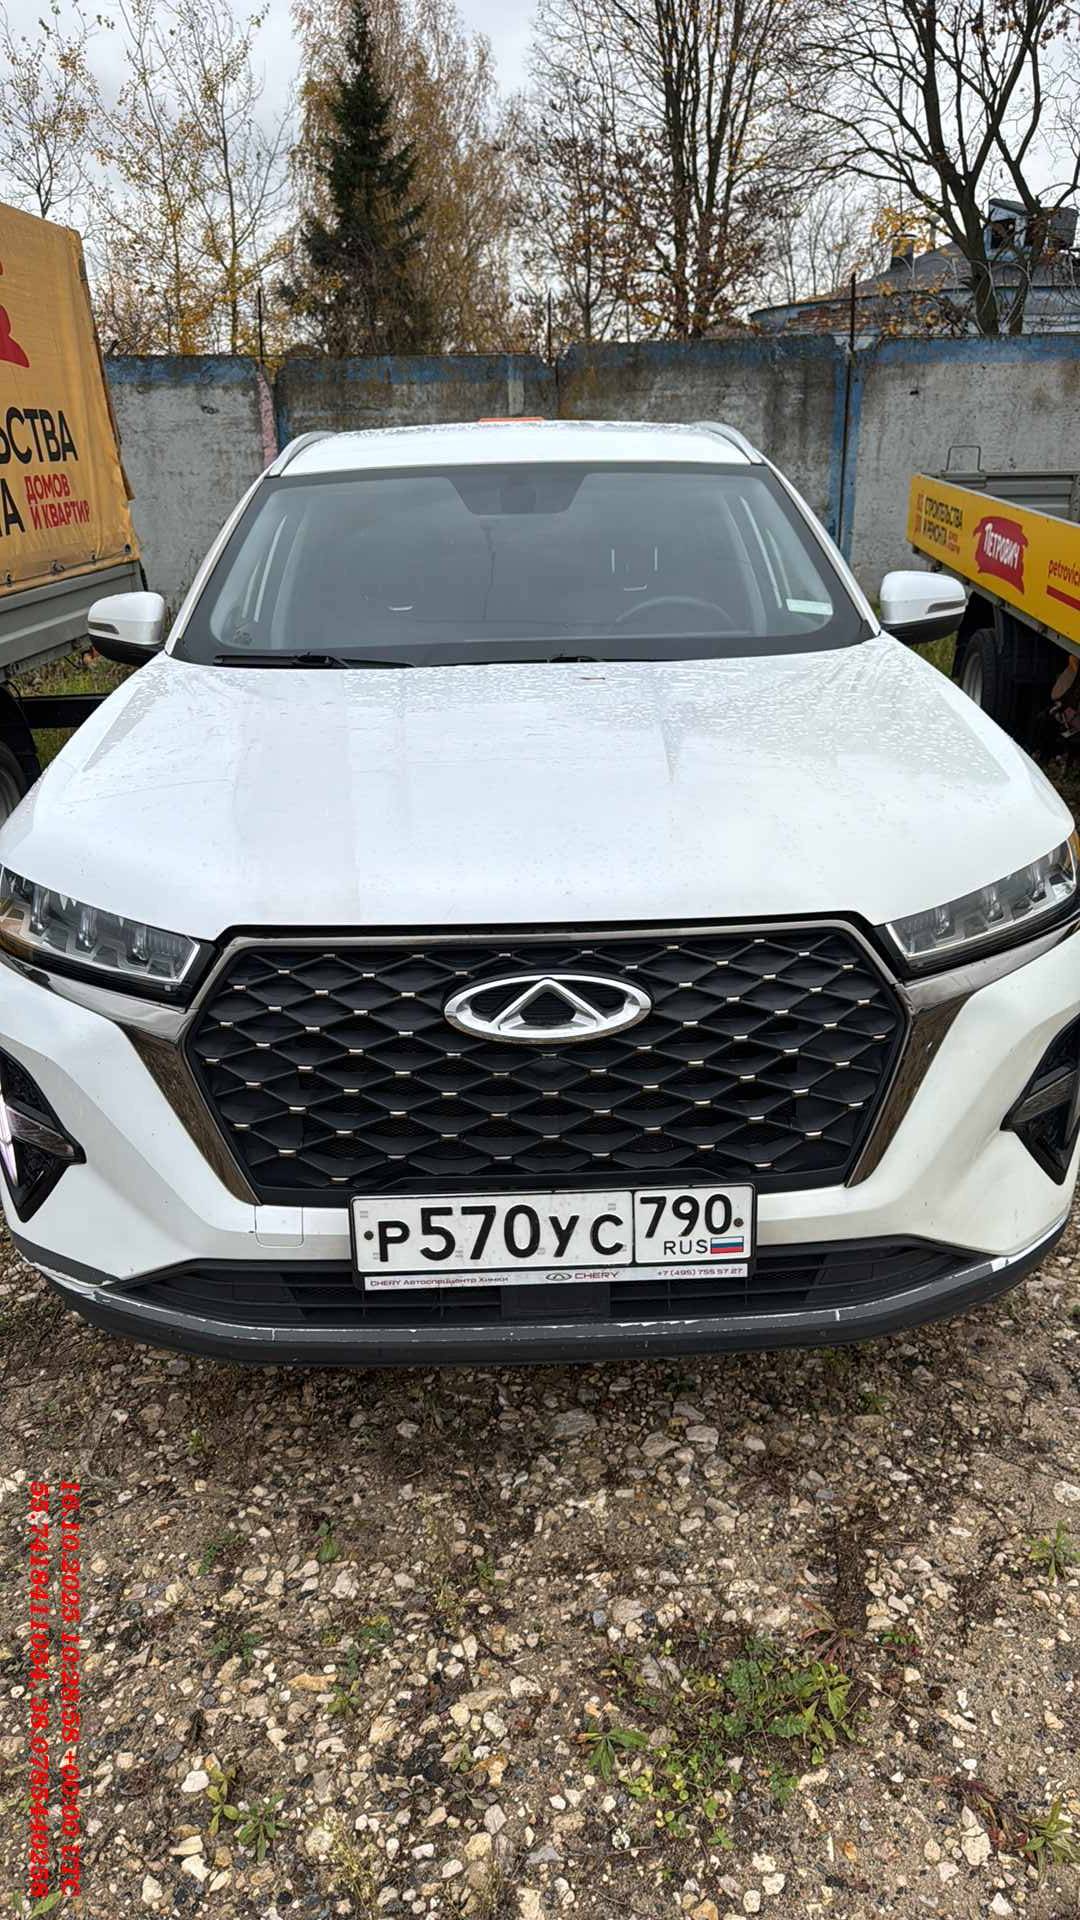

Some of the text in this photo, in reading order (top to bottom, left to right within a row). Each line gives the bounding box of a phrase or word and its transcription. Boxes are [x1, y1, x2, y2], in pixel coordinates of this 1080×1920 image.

[24, 473, 71, 505] ДОМОВ
[30, 499, 90, 531] И КВАРТИР
[639, 1194, 733, 1238] 790
[663, 1239, 709, 1255] RUS
[575, 1271, 620, 1280] CHERY
[670, 1268, 696, 1277] (495)
[370, 1279, 401, 1287] CHERY
